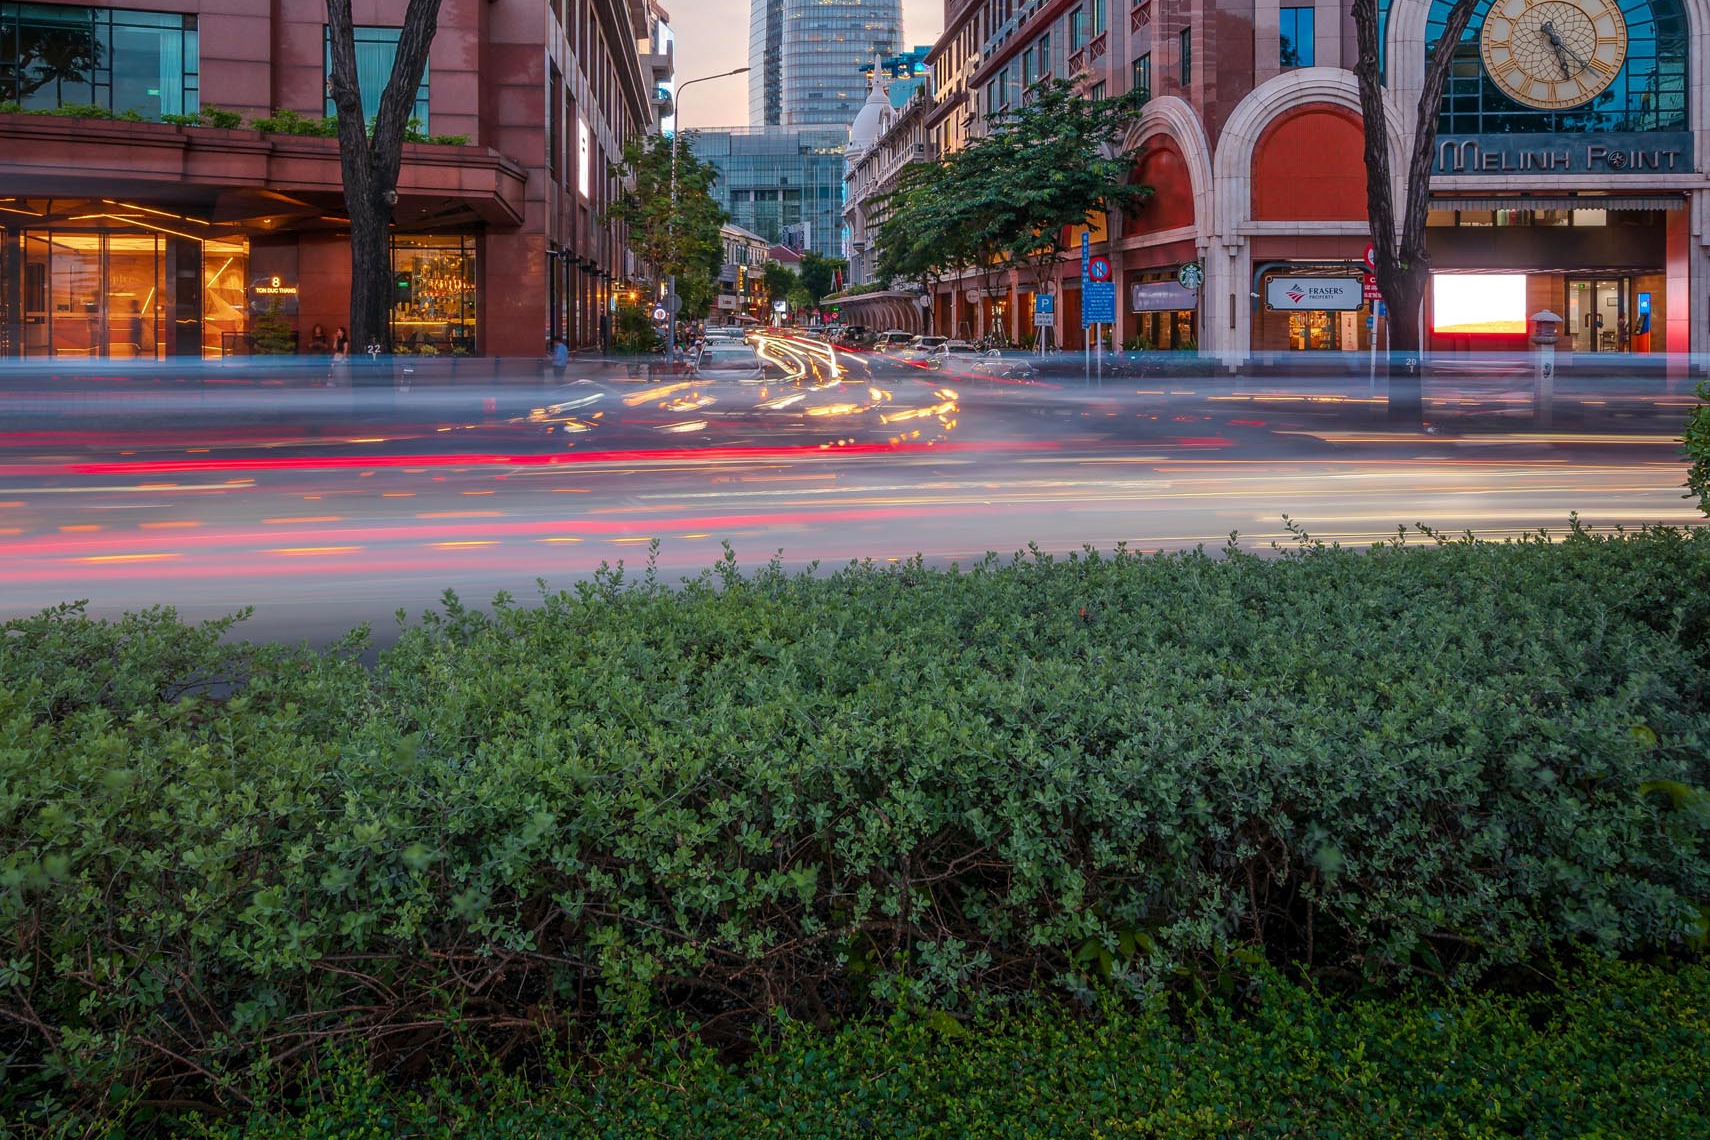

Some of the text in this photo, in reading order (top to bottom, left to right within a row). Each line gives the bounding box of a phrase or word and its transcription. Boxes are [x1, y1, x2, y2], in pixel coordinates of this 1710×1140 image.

[272, 277, 280, 287] 8
[1308, 287, 1344, 295] FRASERS
[1041, 298, 1050, 308] P
